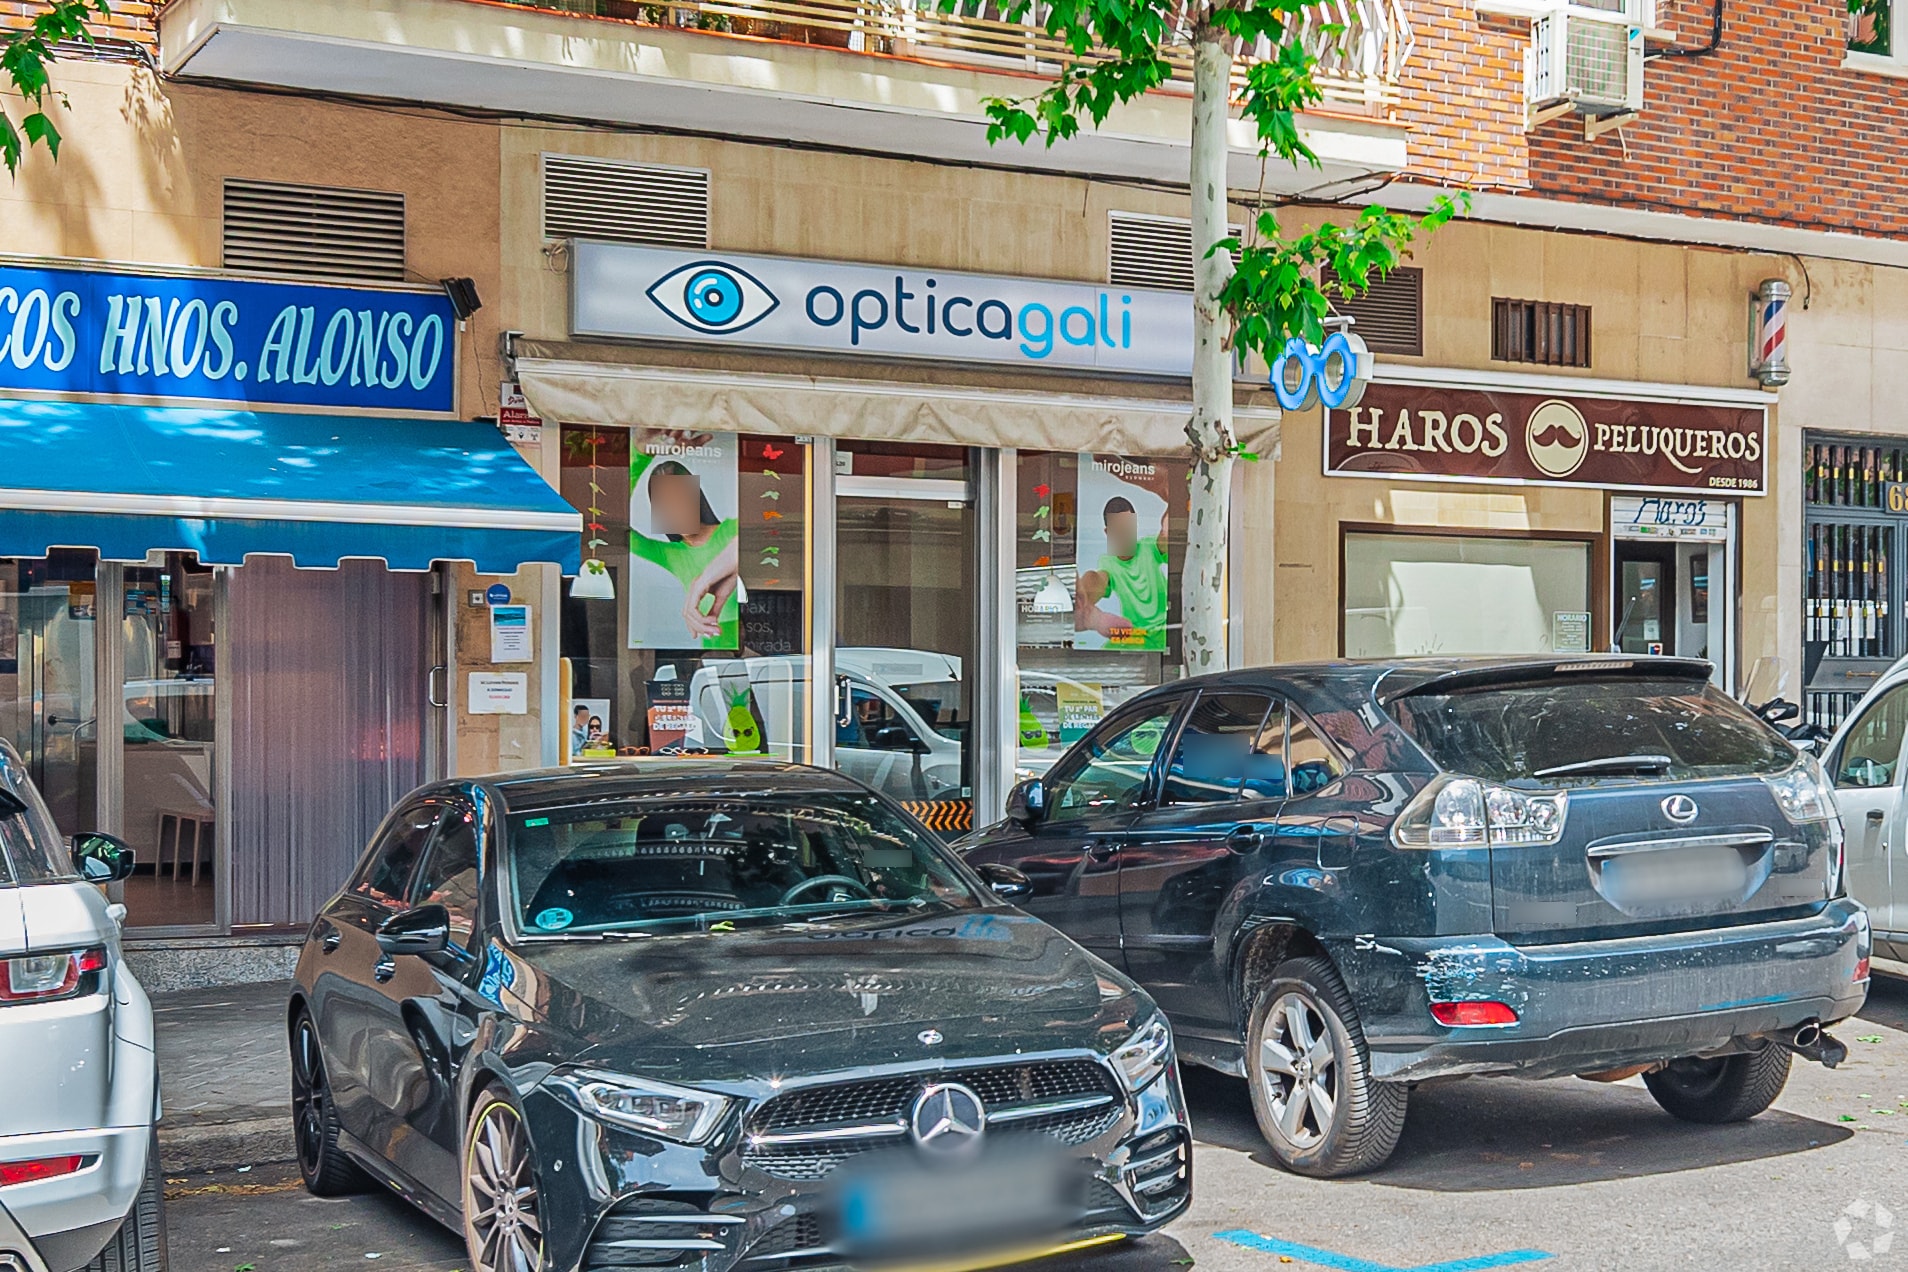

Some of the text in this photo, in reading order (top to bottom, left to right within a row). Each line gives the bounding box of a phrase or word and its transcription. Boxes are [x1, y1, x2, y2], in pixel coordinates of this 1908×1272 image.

[805, 276, 1132, 358] opticagali
[101, 295, 248, 380] HNOS.
[257, 305, 444, 390] ALONSO
[645, 442, 722, 458] mirojeans
[1346, 407, 1760, 473] HAROS PELUQUEROS
[1091, 460, 1156, 477] mirojeans
[1709, 477, 1758, 489] DESDE 1986
